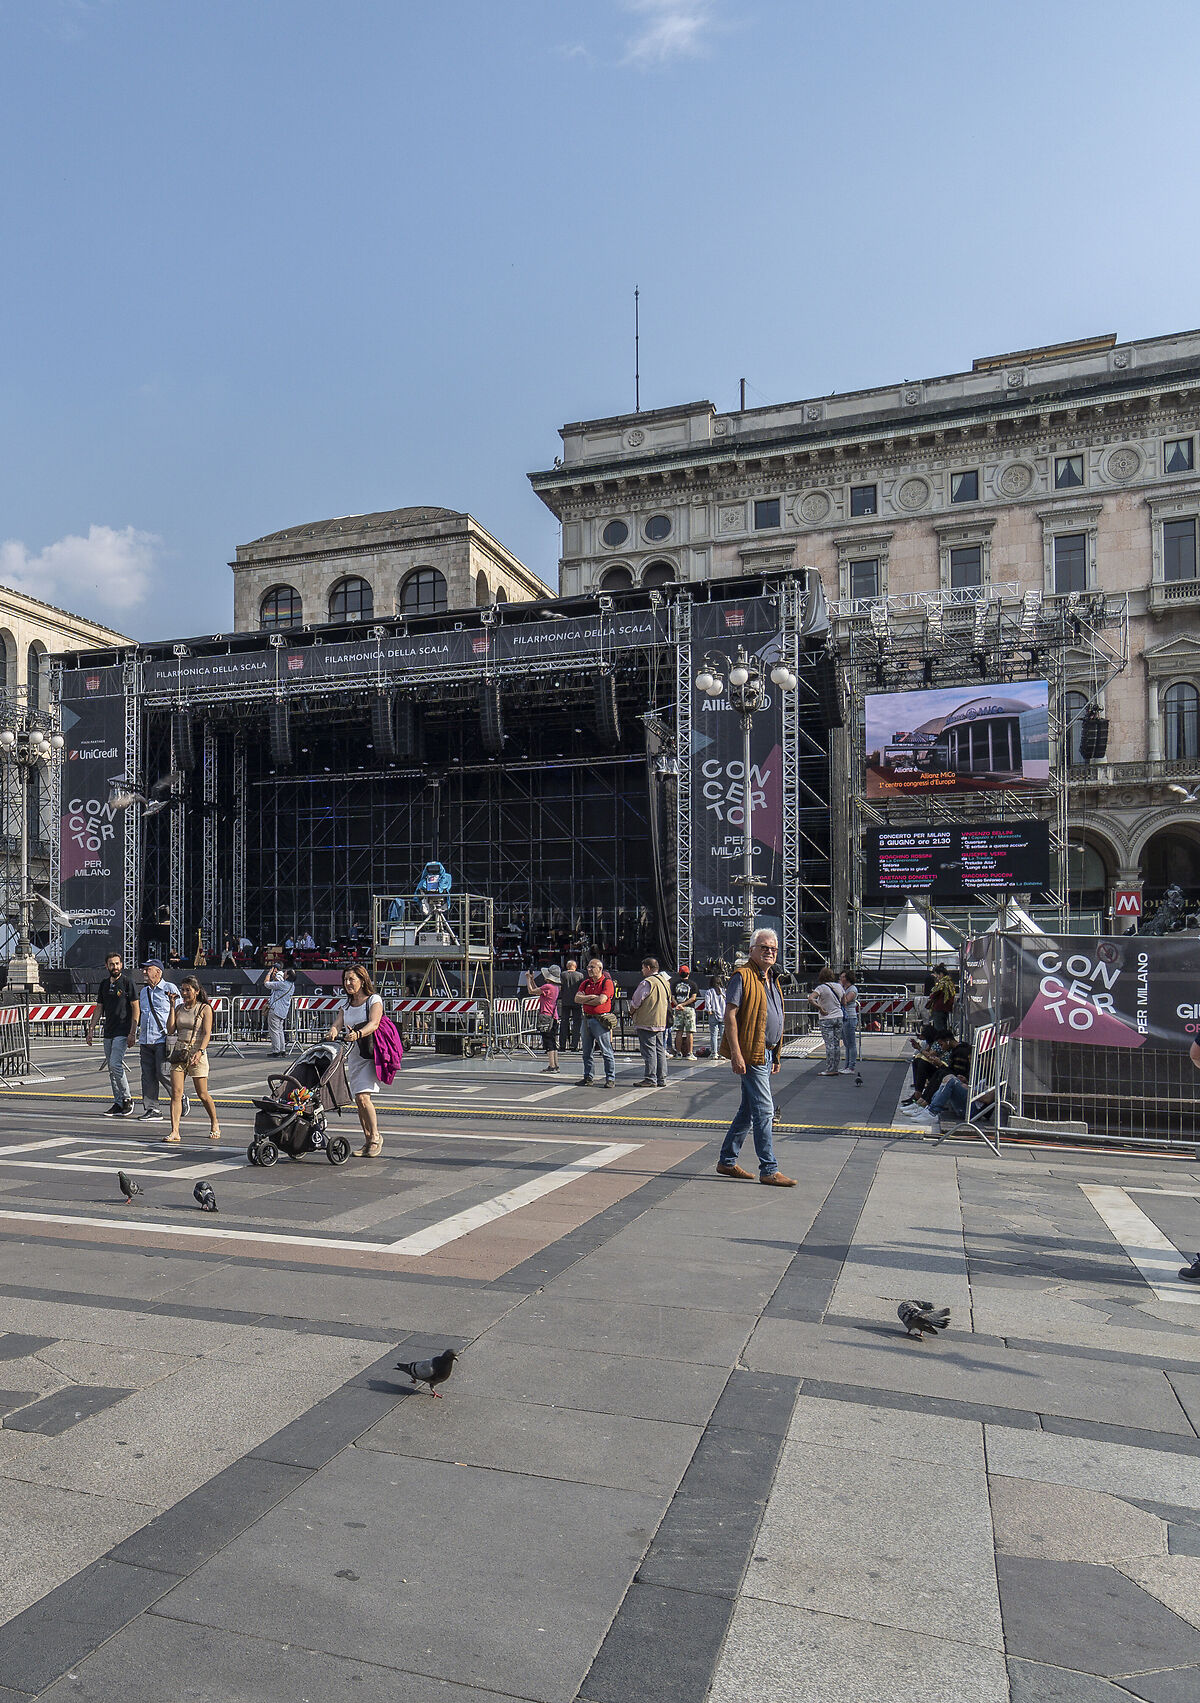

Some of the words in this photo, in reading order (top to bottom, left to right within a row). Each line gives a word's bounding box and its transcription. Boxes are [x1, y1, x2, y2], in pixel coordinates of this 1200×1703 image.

[513, 631, 581, 645] FILARMONICA
[584, 627, 615, 638] DELLA
[618, 624, 652, 634] SCALA
[324, 651, 385, 663] FILARMONICA
[387, 648, 417, 658] DELLA
[419, 645, 449, 655] SCALA
[156, 667, 210, 678] FILARMONICA
[212, 665, 238, 674] DELLA
[240, 662, 267, 671] SCALA
[80, 747, 118, 760] UniCredit
[711, 846, 762, 856] MILAO
[84, 860, 102, 868] PER
[74, 868, 111, 877] MILANO
[699, 896, 734, 905] JUAN
[738, 896, 776, 905] DEGO
[1117, 895, 1140, 911] M
[69, 908, 116, 917] RICCARDO
[74, 918, 112, 926] CHAILLY
[1137, 952, 1149, 1005] MILANO
[1176, 1003, 1200, 1019] GI
[1137, 1010, 1149, 1035] PER
